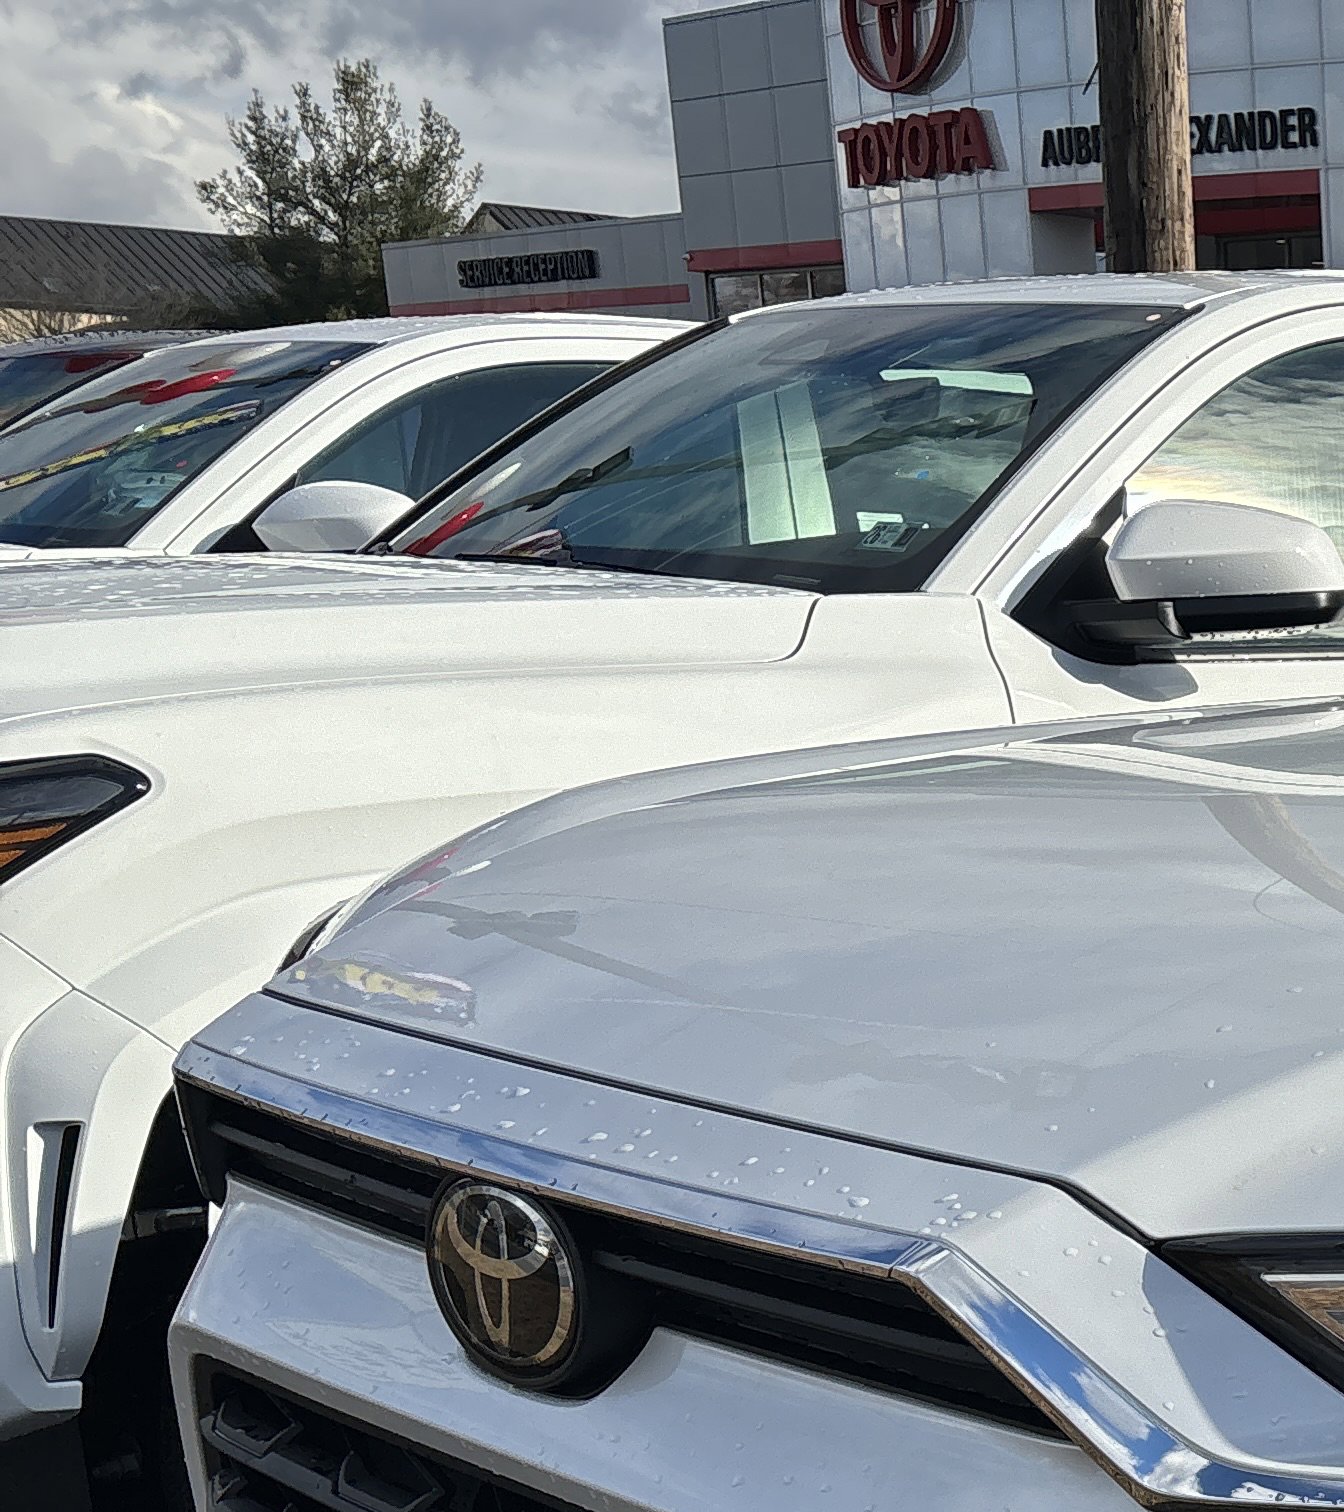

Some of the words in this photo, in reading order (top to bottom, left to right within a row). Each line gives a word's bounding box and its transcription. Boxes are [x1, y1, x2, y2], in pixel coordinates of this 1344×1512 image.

[837, 107, 994, 188] TOYOTA
[1041, 125, 1101, 168] AUB
[1190, 107, 1319, 154] EXANDER
[458, 258, 511, 288] SERVICE
[511, 249, 597, 284] RECEPTION
